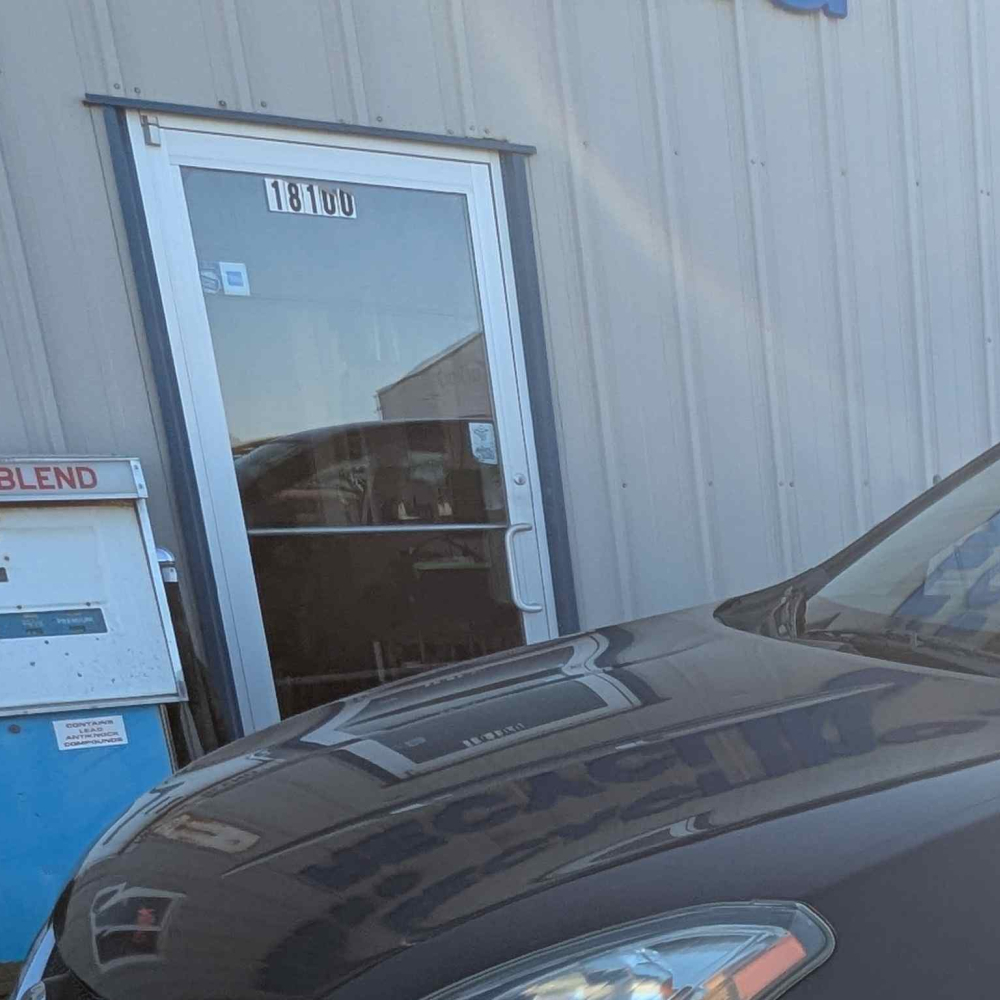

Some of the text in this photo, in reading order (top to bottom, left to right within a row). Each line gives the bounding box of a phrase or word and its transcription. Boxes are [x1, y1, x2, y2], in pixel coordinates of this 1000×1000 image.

[271, 180, 354, 217] 18100
[0, 466, 98, 490] BLEND
[65, 719, 114, 728] CONTAINS
